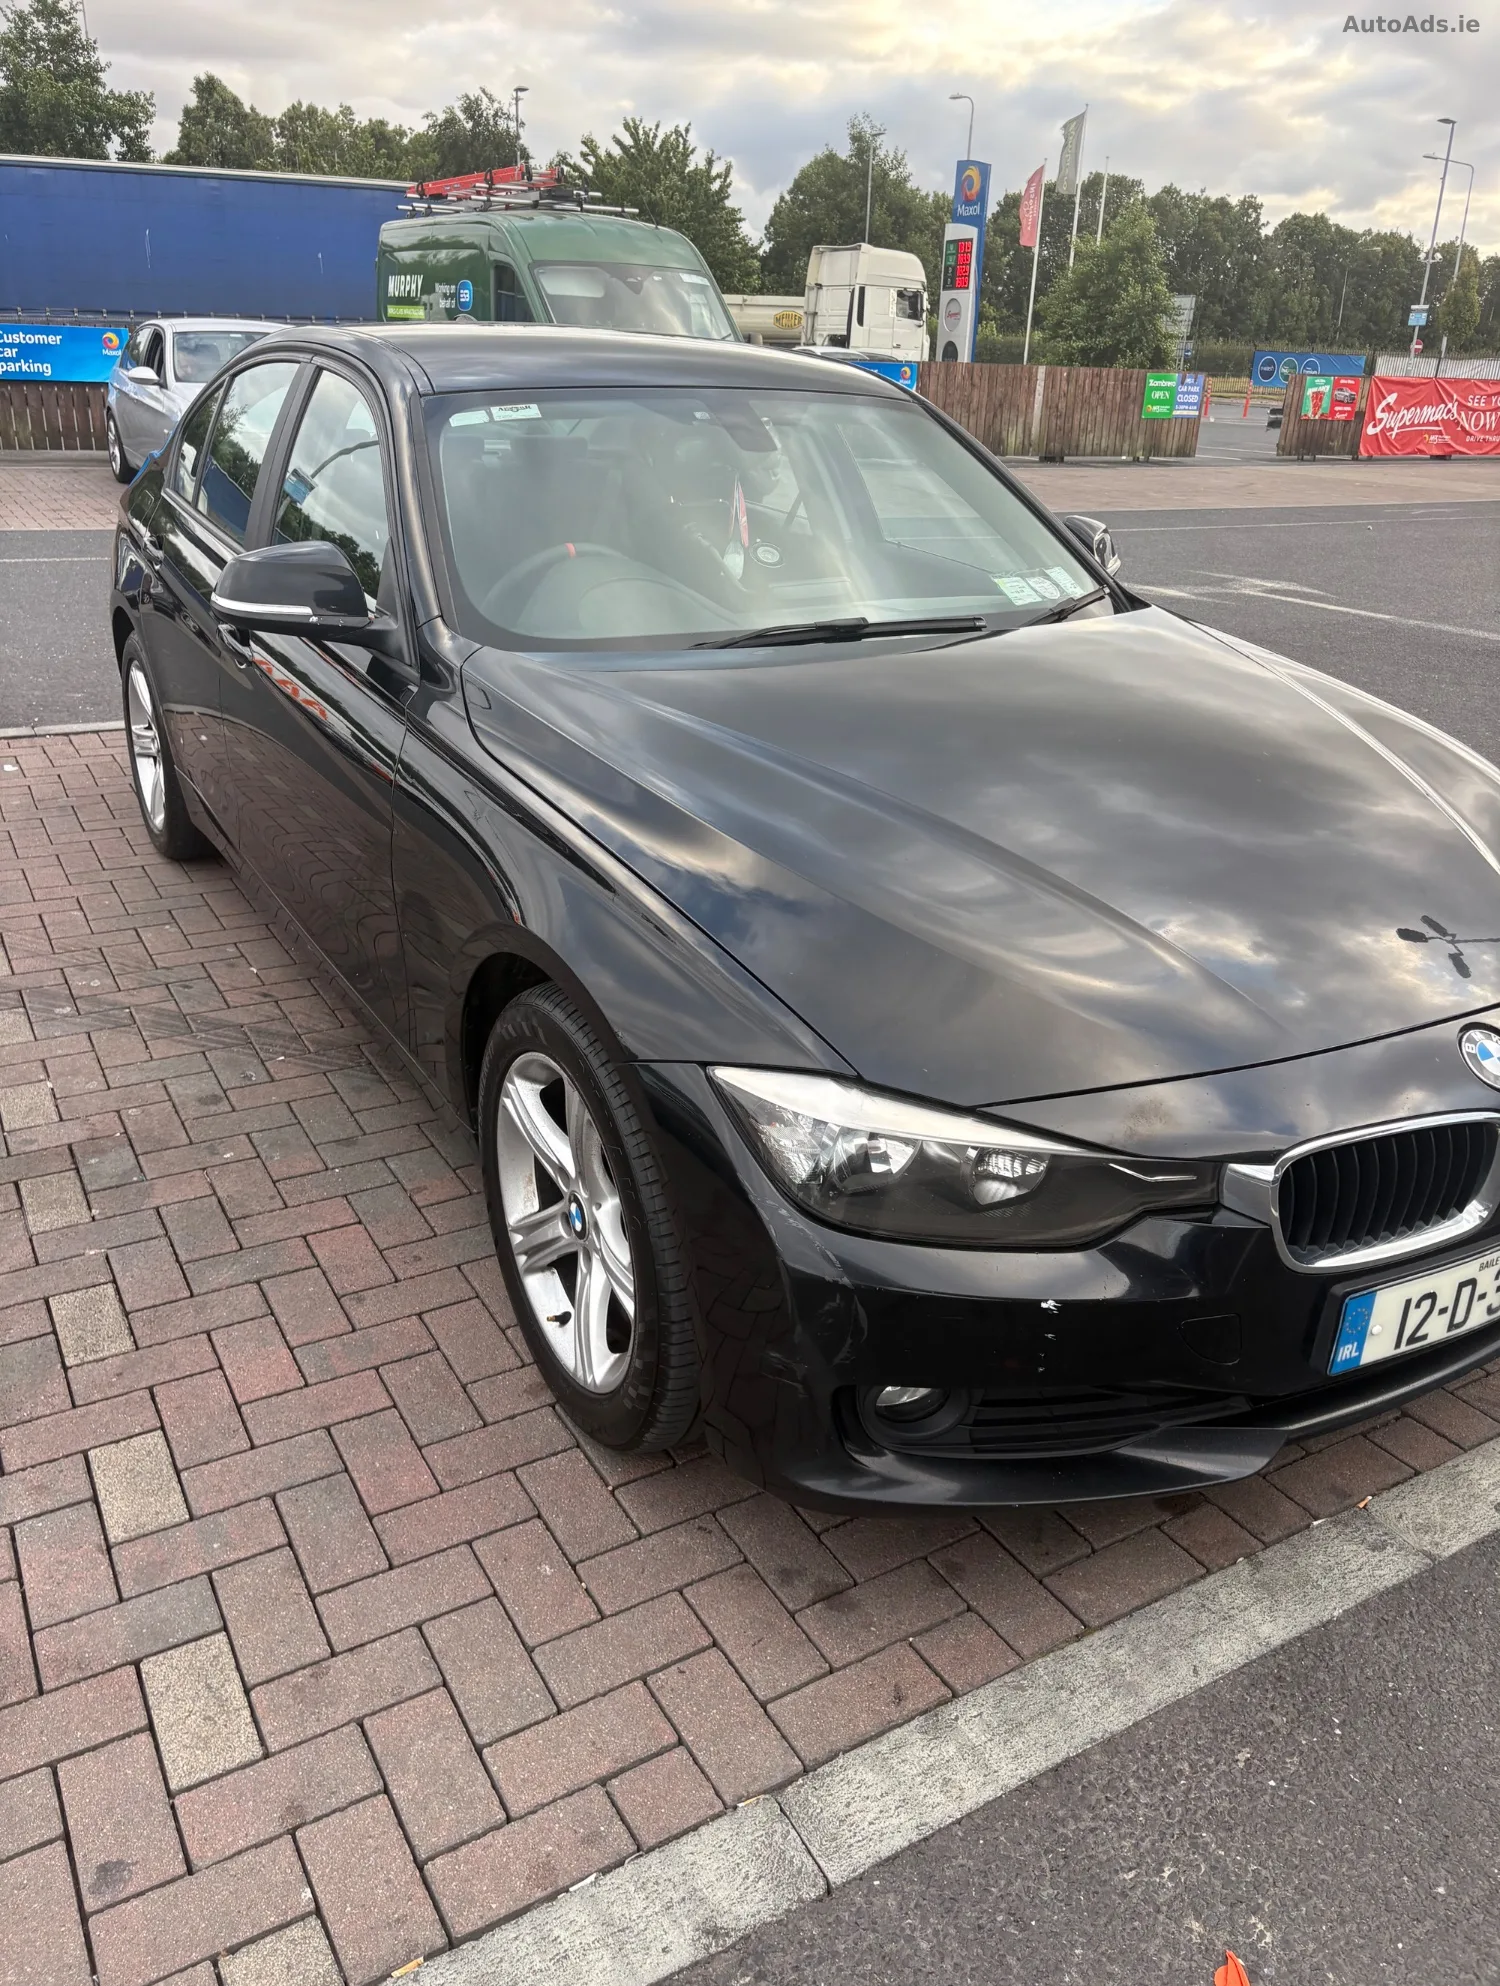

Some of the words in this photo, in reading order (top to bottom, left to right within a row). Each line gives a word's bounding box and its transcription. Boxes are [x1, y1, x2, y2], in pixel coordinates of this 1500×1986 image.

[956, 202, 980, 217] Maxol
[388, 274, 424, 297] MURPHY
[775, 312, 803, 328] MEILLER
[0, 358, 52, 377] parking
[1151, 390, 1171, 400] OPEN
[1177, 394, 1199, 403] CLOSED
[1467, 394, 1487, 407] SEE
[1366, 392, 1458, 440] Supermac's
[1456, 410, 1500, 431] NOW
[1337, 1341, 1360, 1362] IRL
